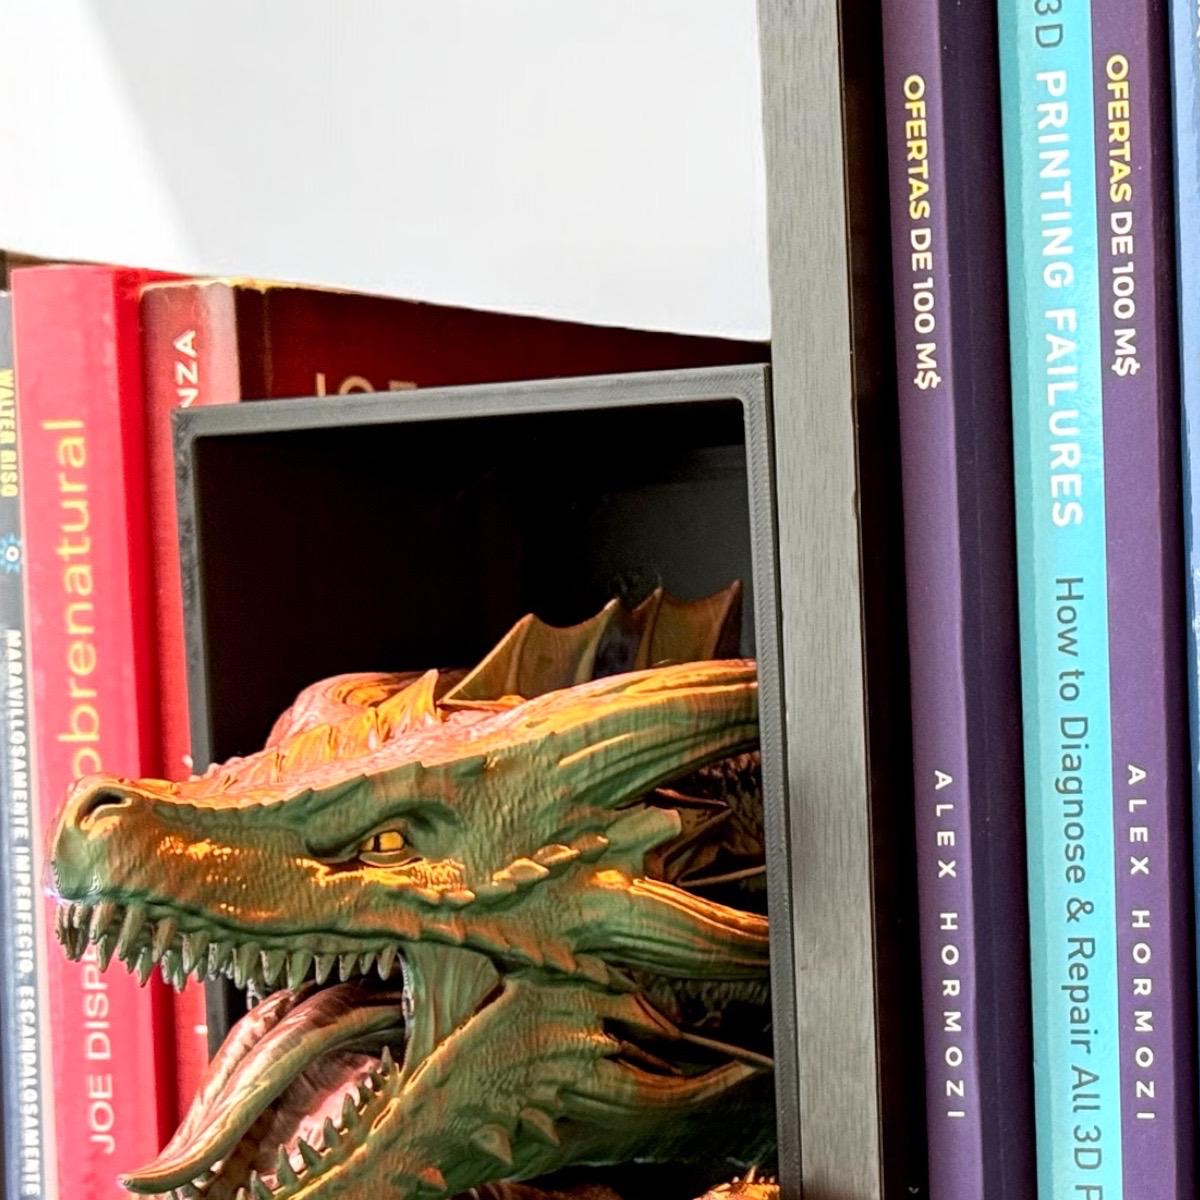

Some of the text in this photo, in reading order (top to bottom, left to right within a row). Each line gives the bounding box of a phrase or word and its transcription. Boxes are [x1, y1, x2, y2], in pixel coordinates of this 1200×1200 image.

[903, 75, 942, 390] OFERTAS DE 100 M$
[1034, 0, 1084, 528] 3D PRINTING FAILURES
[1105, 54, 1141, 377] OFERTAS DE 100 M$
[41, 420, 102, 778] obrenatural
[1055, 577, 1085, 657] How
[1058, 669, 1085, 702] to
[7, 629, 29, 840] MARAVILLOSAMENTE
[1055, 716, 1089, 884] Diagnose
[934, 770, 965, 1118] ALEX HORMOZI
[1061, 936, 1099, 1053] Repair
[1066, 898, 1095, 923] &
[1127, 765, 1155, 1119] ALEX HORMOZI
[17, 986, 42, 1196] ESCANDALOSAMENTE
[89, 1074, 116, 1154] JOE
[1071, 1065, 1101, 1113] All
[1073, 1125, 1103, 1170] 3D
